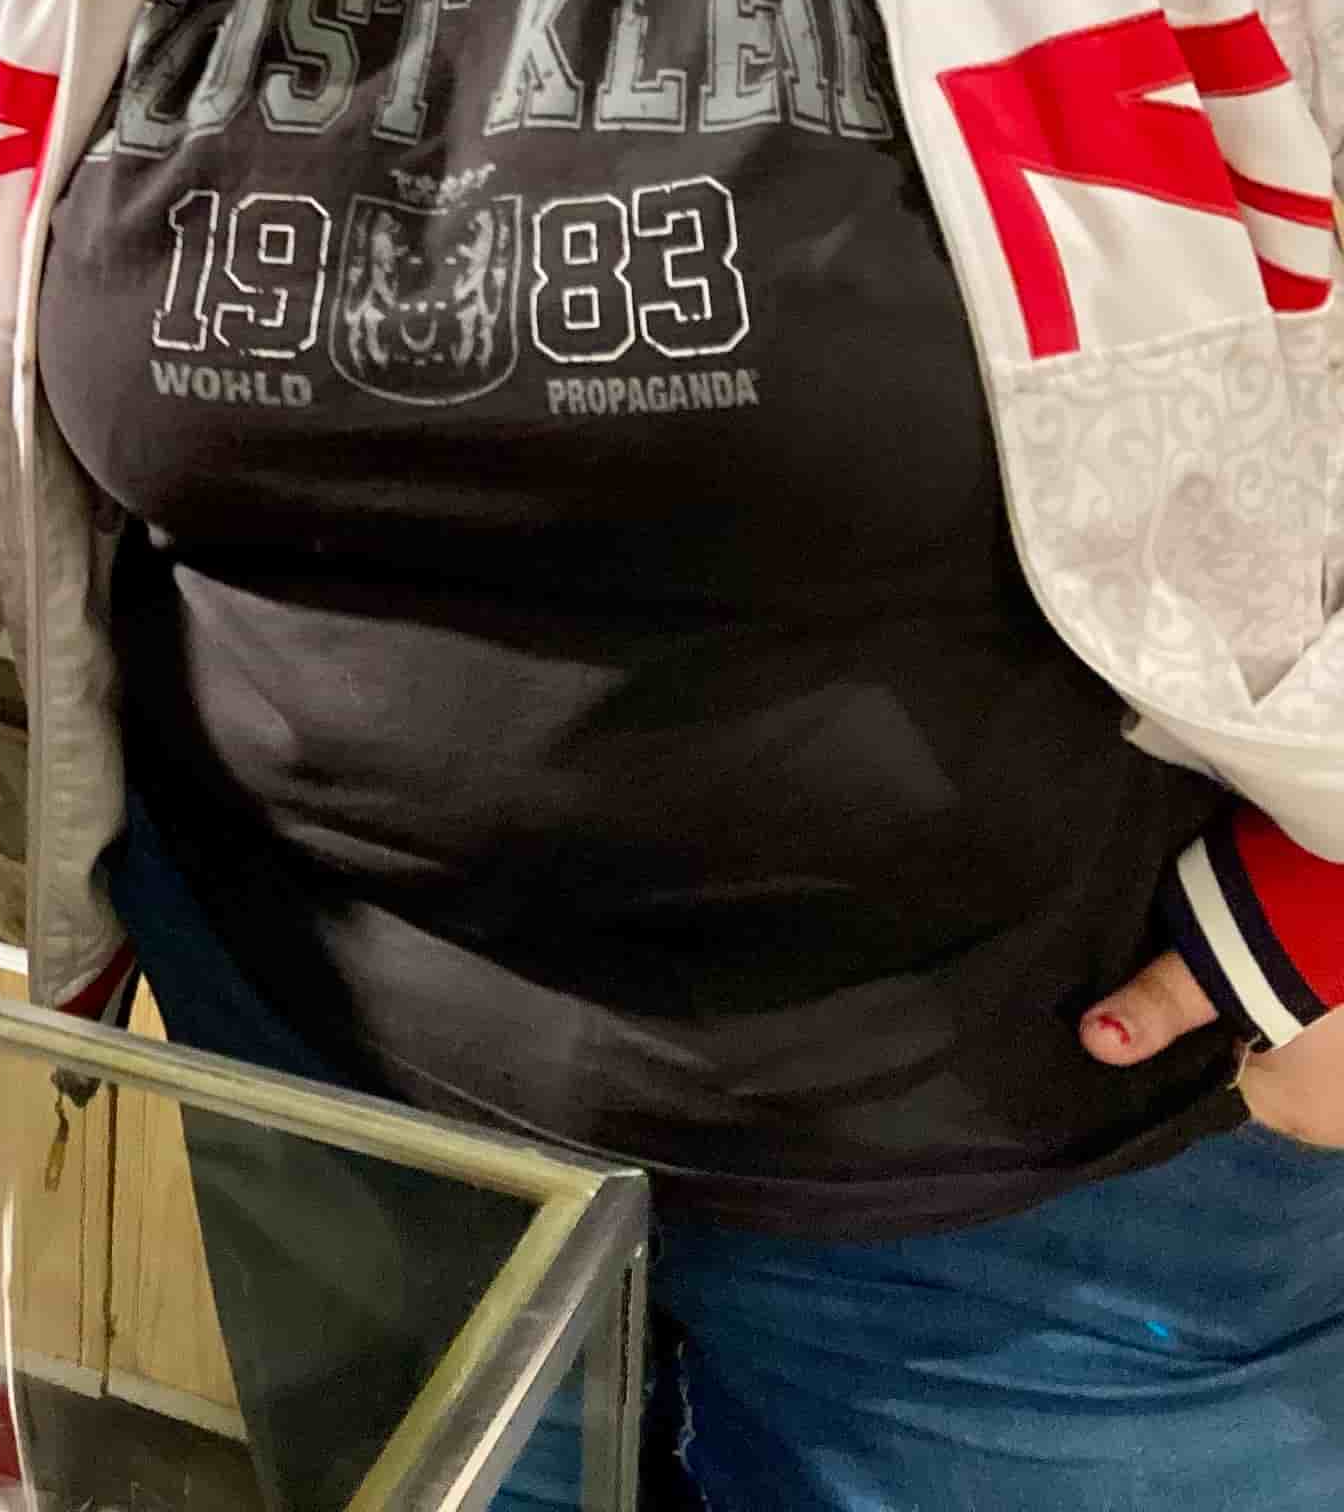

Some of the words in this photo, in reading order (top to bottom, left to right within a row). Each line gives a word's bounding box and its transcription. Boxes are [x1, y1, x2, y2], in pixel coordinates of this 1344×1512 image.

[152, 189, 332, 358] 19
[529, 175, 750, 363] 83
[150, 359, 312, 408] WORLD
[546, 367, 759, 416] PROPAGANDA
